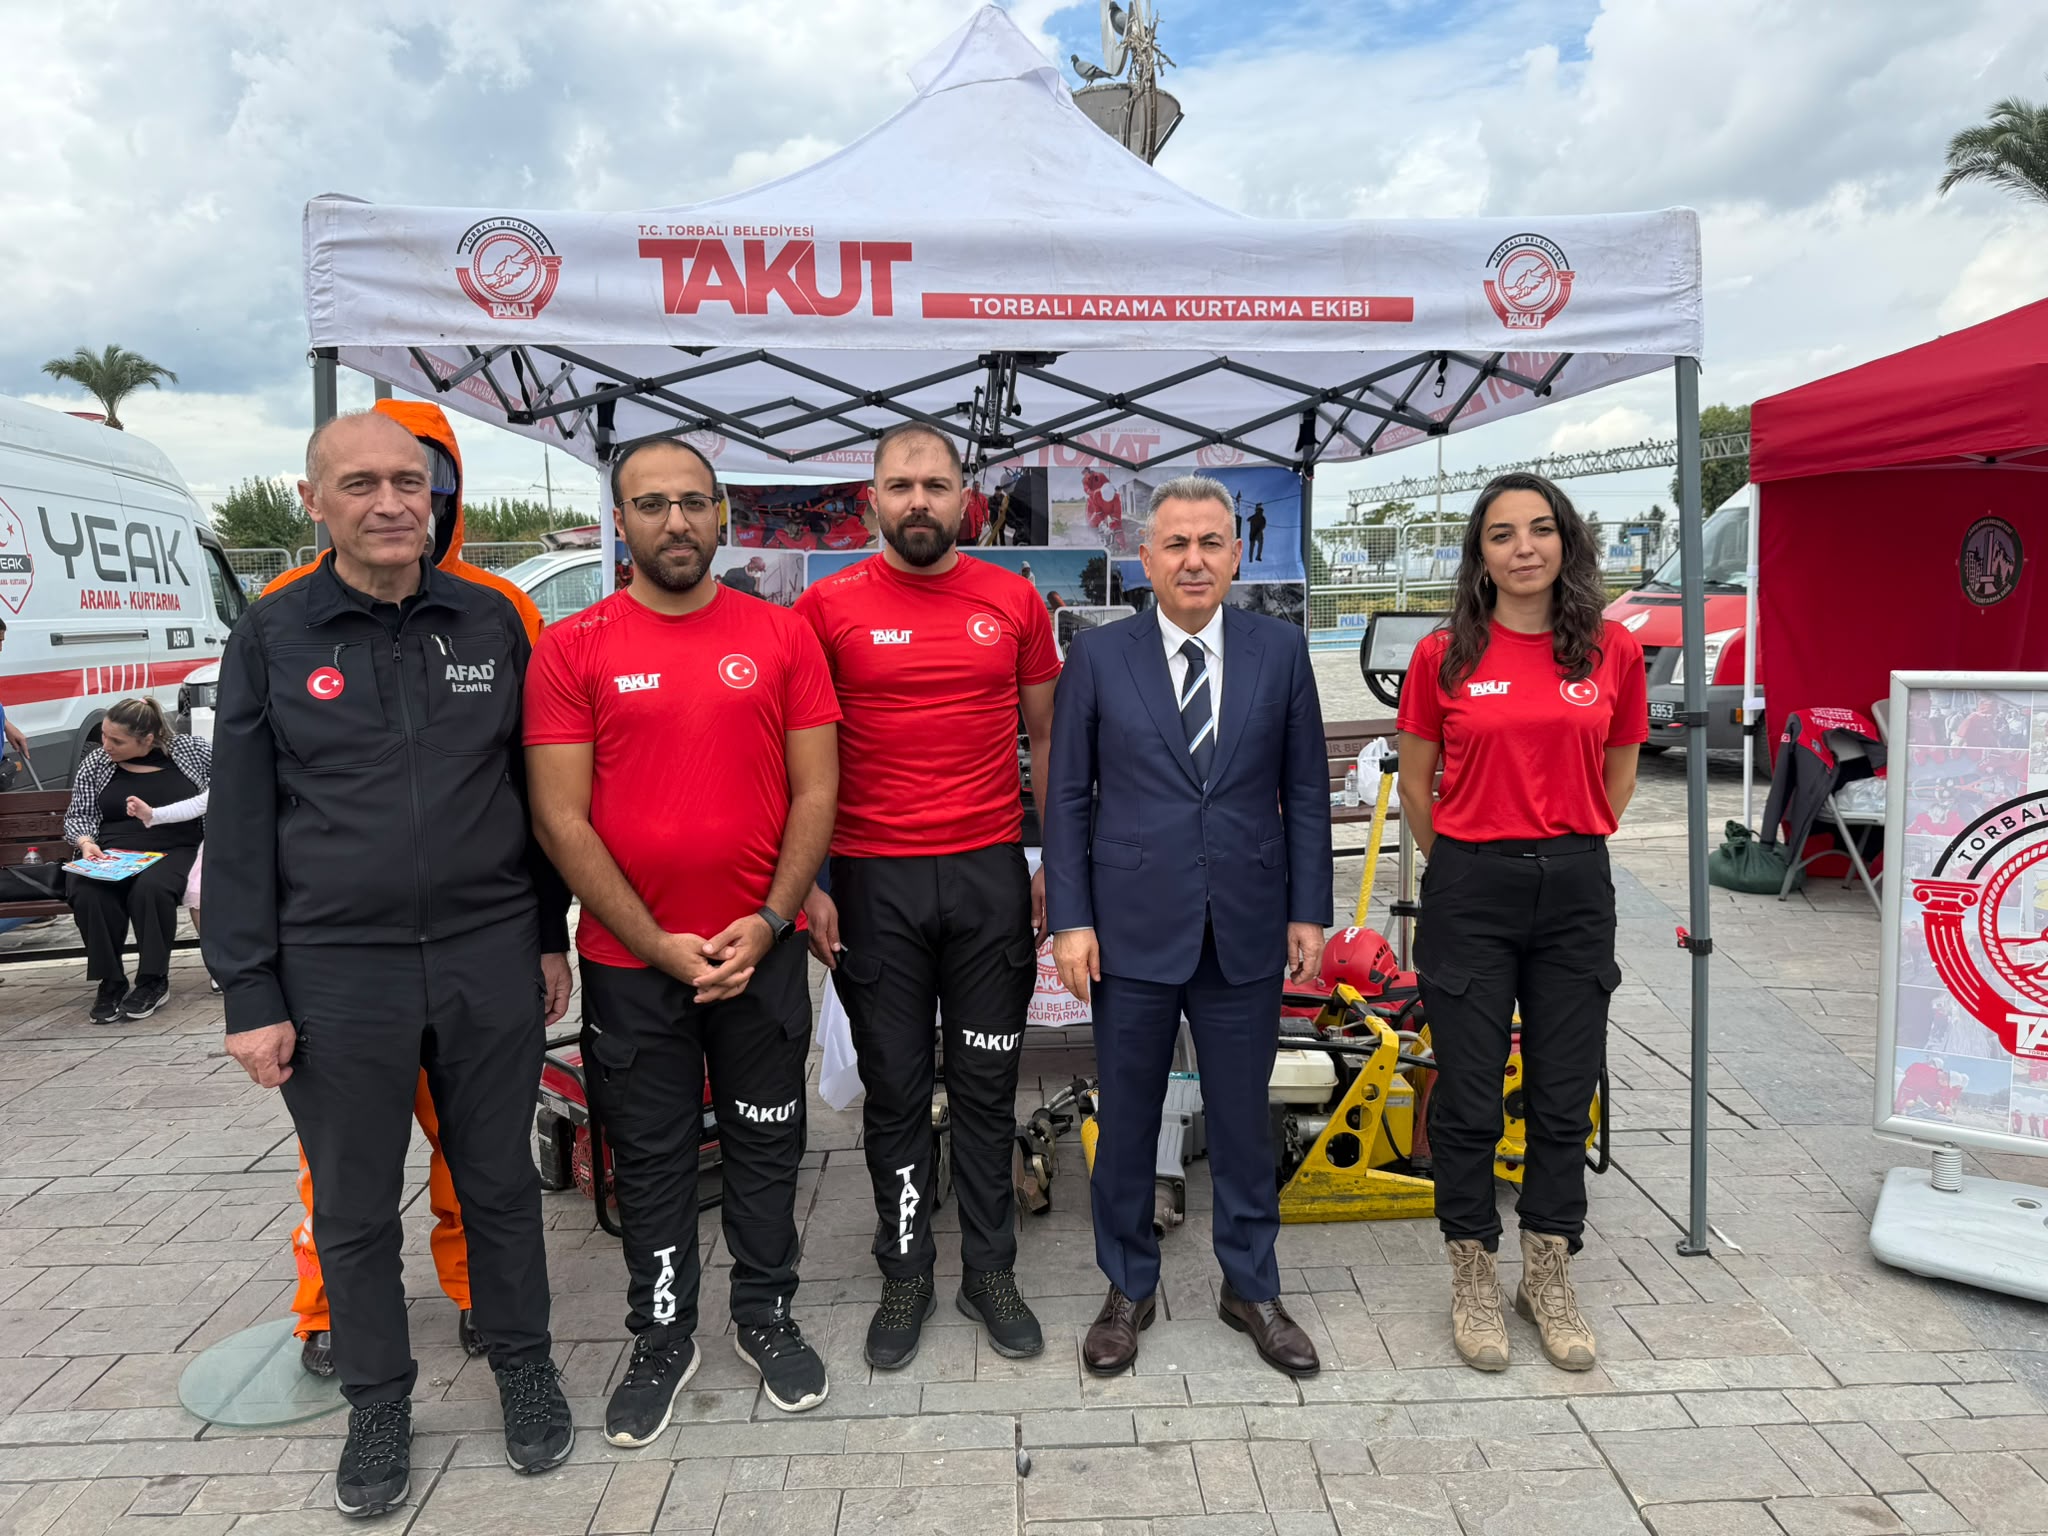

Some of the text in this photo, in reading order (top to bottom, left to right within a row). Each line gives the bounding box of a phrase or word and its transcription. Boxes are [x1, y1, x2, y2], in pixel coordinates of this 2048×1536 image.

[463, 221, 496, 248] TORBALI
[638, 224, 814, 237] T.C. TORBALI BELEDİYESİ
[638, 238, 912, 317] TAKUT
[489, 303, 535, 316] TAKUT
[969, 297, 1072, 316] TORBALI
[1081, 299, 1167, 316] ARAMA
[1175, 299, 1302, 318] KURTARMA
[1506, 313, 1546, 327] TAKUT
[37, 506, 190, 586] YEAK
[0, 557, 24, 570] EAK
[1341, 550, 1367, 563] POLİS
[80, 589, 122, 610] ARAMA
[129, 590, 182, 611] KURTARMA
[1340, 615, 1366, 627] POLİS
[173, 631, 189, 646] AFAD
[870, 629, 912, 644] TAKUT
[445, 664, 495, 680] AFAD
[452, 682, 493, 692] İZMİR
[613, 673, 661, 693] TAKUT
[1467, 680, 1511, 696] TAKUT
[1650, 703, 1673, 718] 6953
[1029, 1010, 1088, 1022] KURTARMA
[735, 1099, 797, 1122] TAKUT
